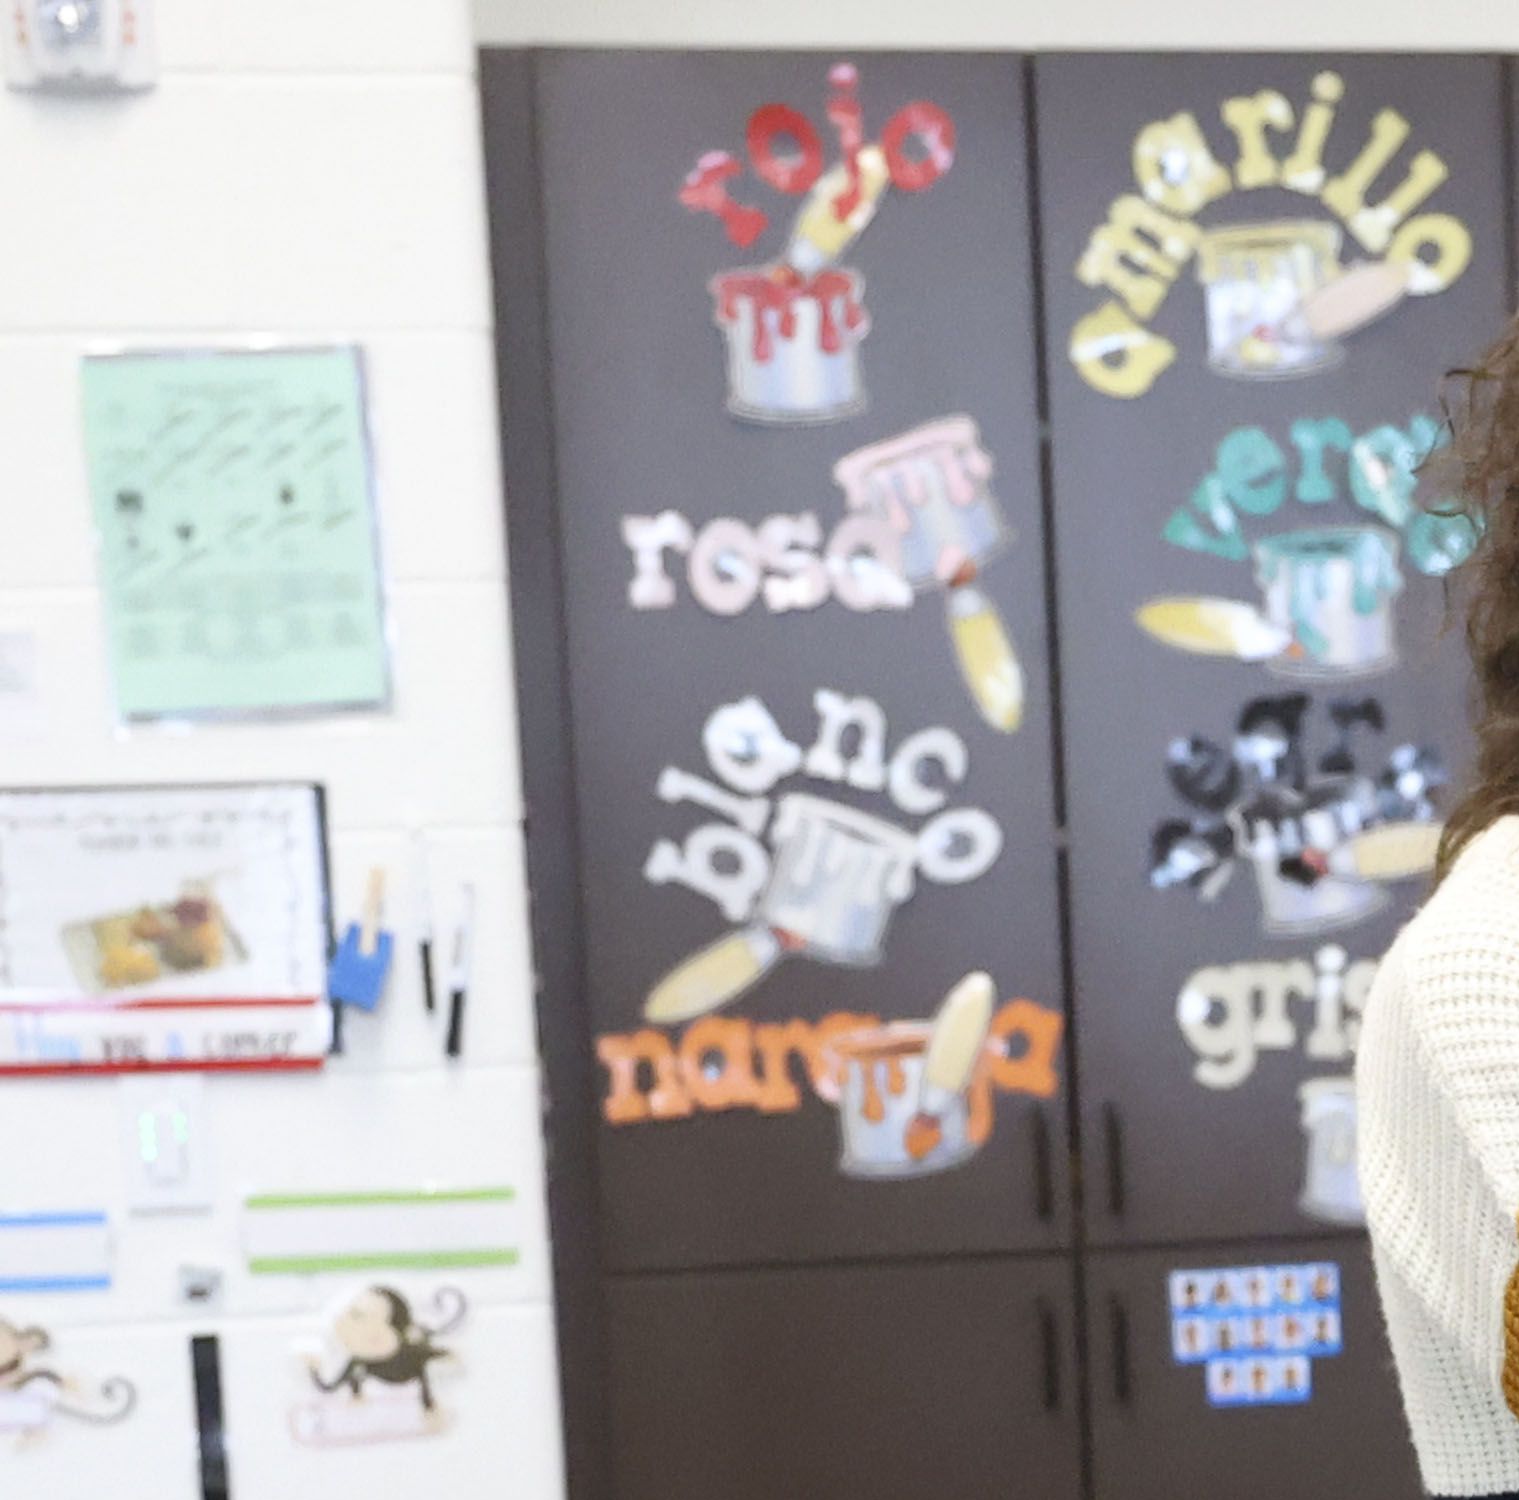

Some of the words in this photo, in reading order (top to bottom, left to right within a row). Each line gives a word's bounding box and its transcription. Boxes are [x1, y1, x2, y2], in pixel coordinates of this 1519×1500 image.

[680, 63, 956, 248] rojo
[1068, 70, 1473, 398] amarillo
[621, 509, 914, 615] rosa
[644, 689, 1001, 921] blanco
